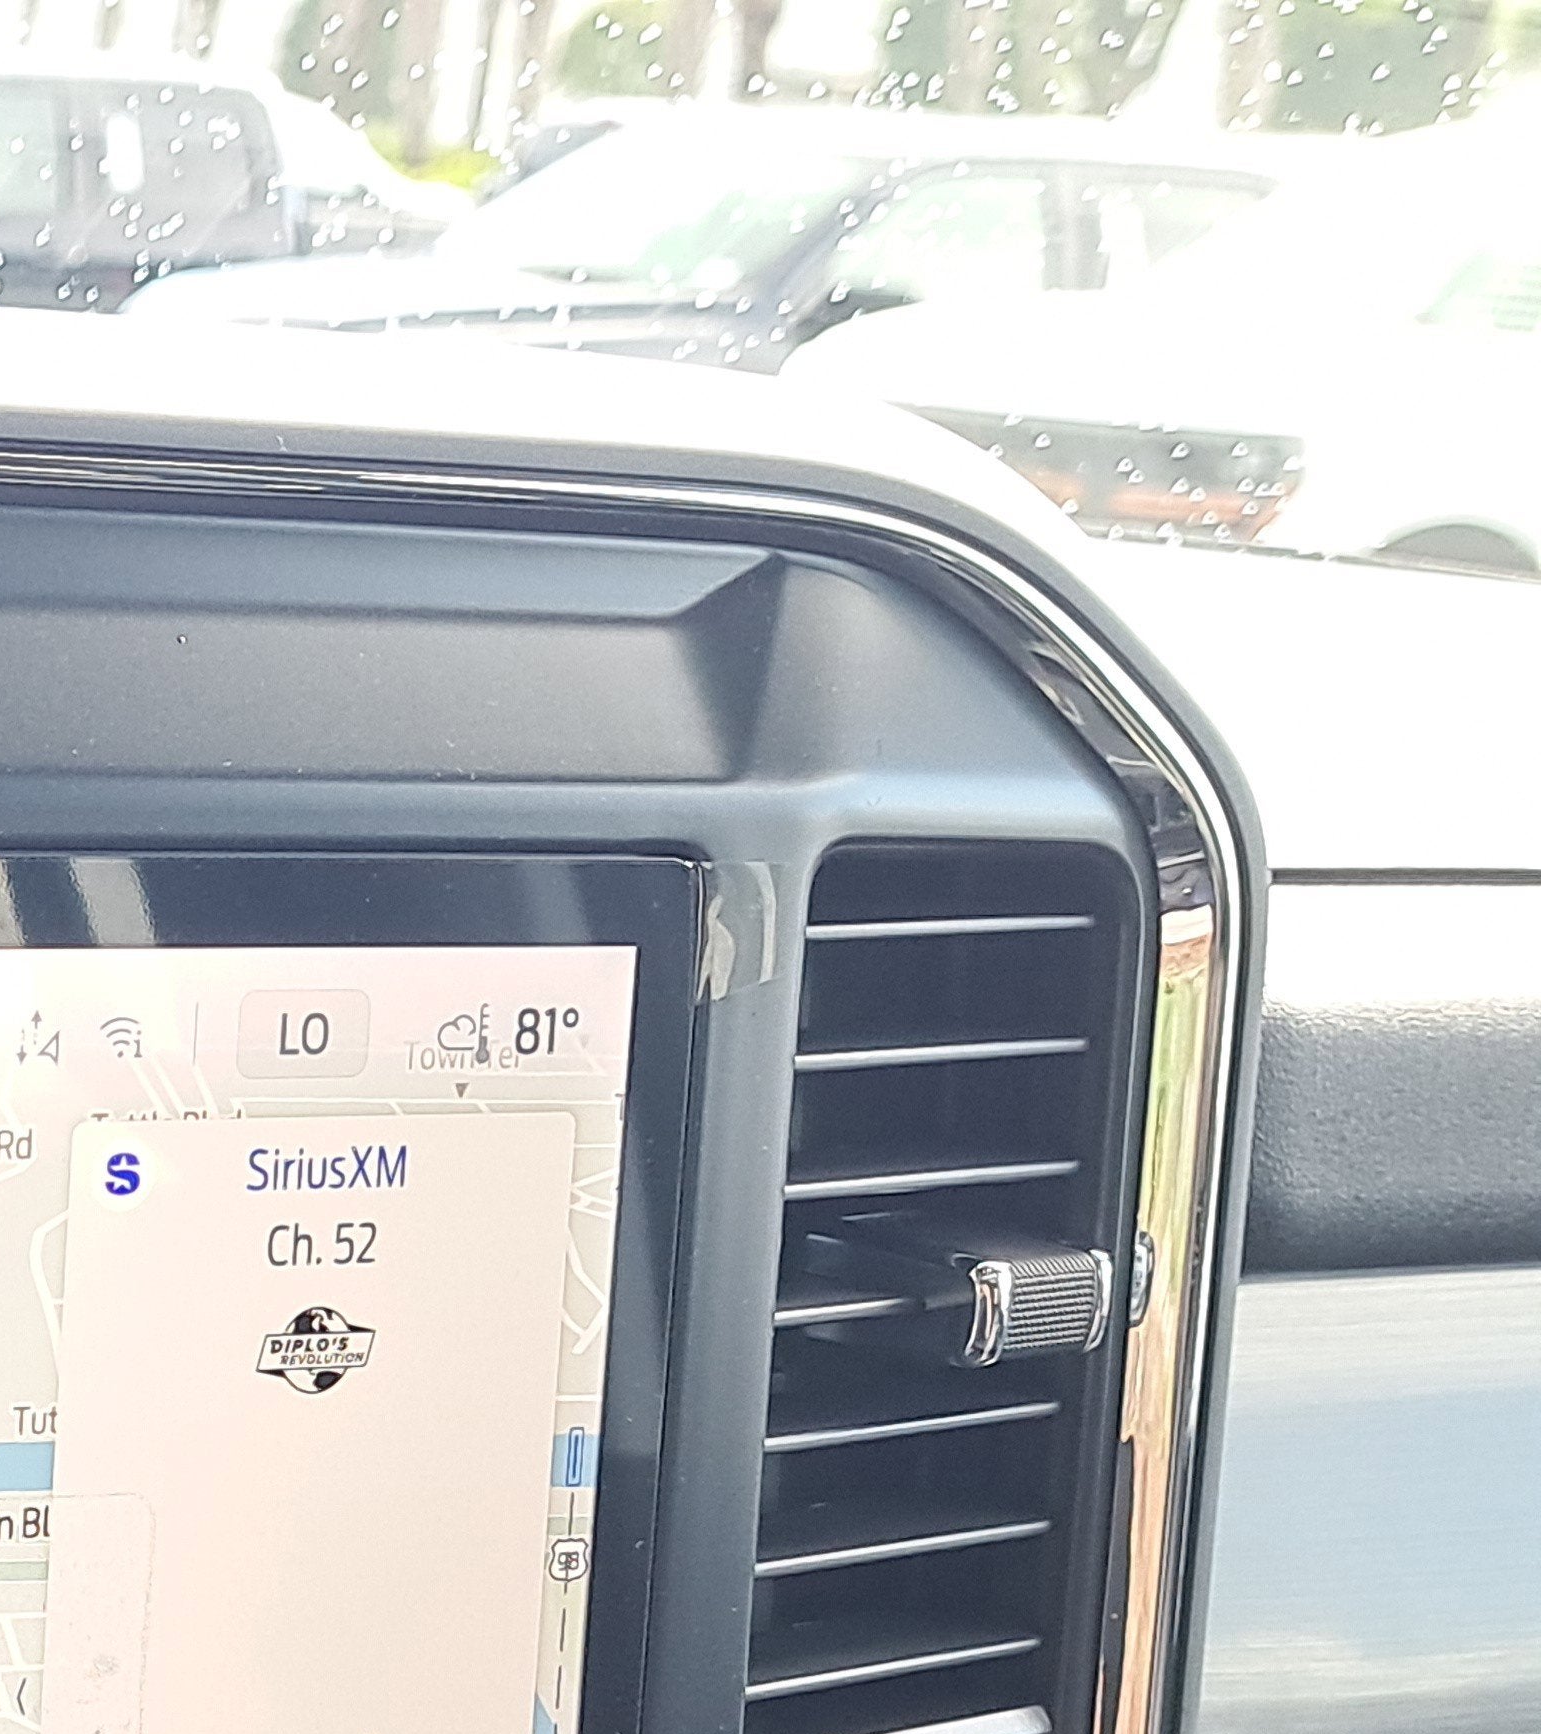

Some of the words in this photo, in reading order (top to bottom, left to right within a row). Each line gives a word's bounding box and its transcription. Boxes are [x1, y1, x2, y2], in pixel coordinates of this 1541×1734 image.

[279, 1014, 329, 1056] LO
[516, 1007, 579, 1055] 81°
[0, 1130, 33, 1160] Rd
[247, 1147, 407, 1191] SiriusXM
[268, 1223, 322, 1266] Ch.
[334, 1223, 376, 1263] 52
[270, 1337, 349, 1354] DIPLO'S
[279, 1352, 365, 1365] REVOLUTION
